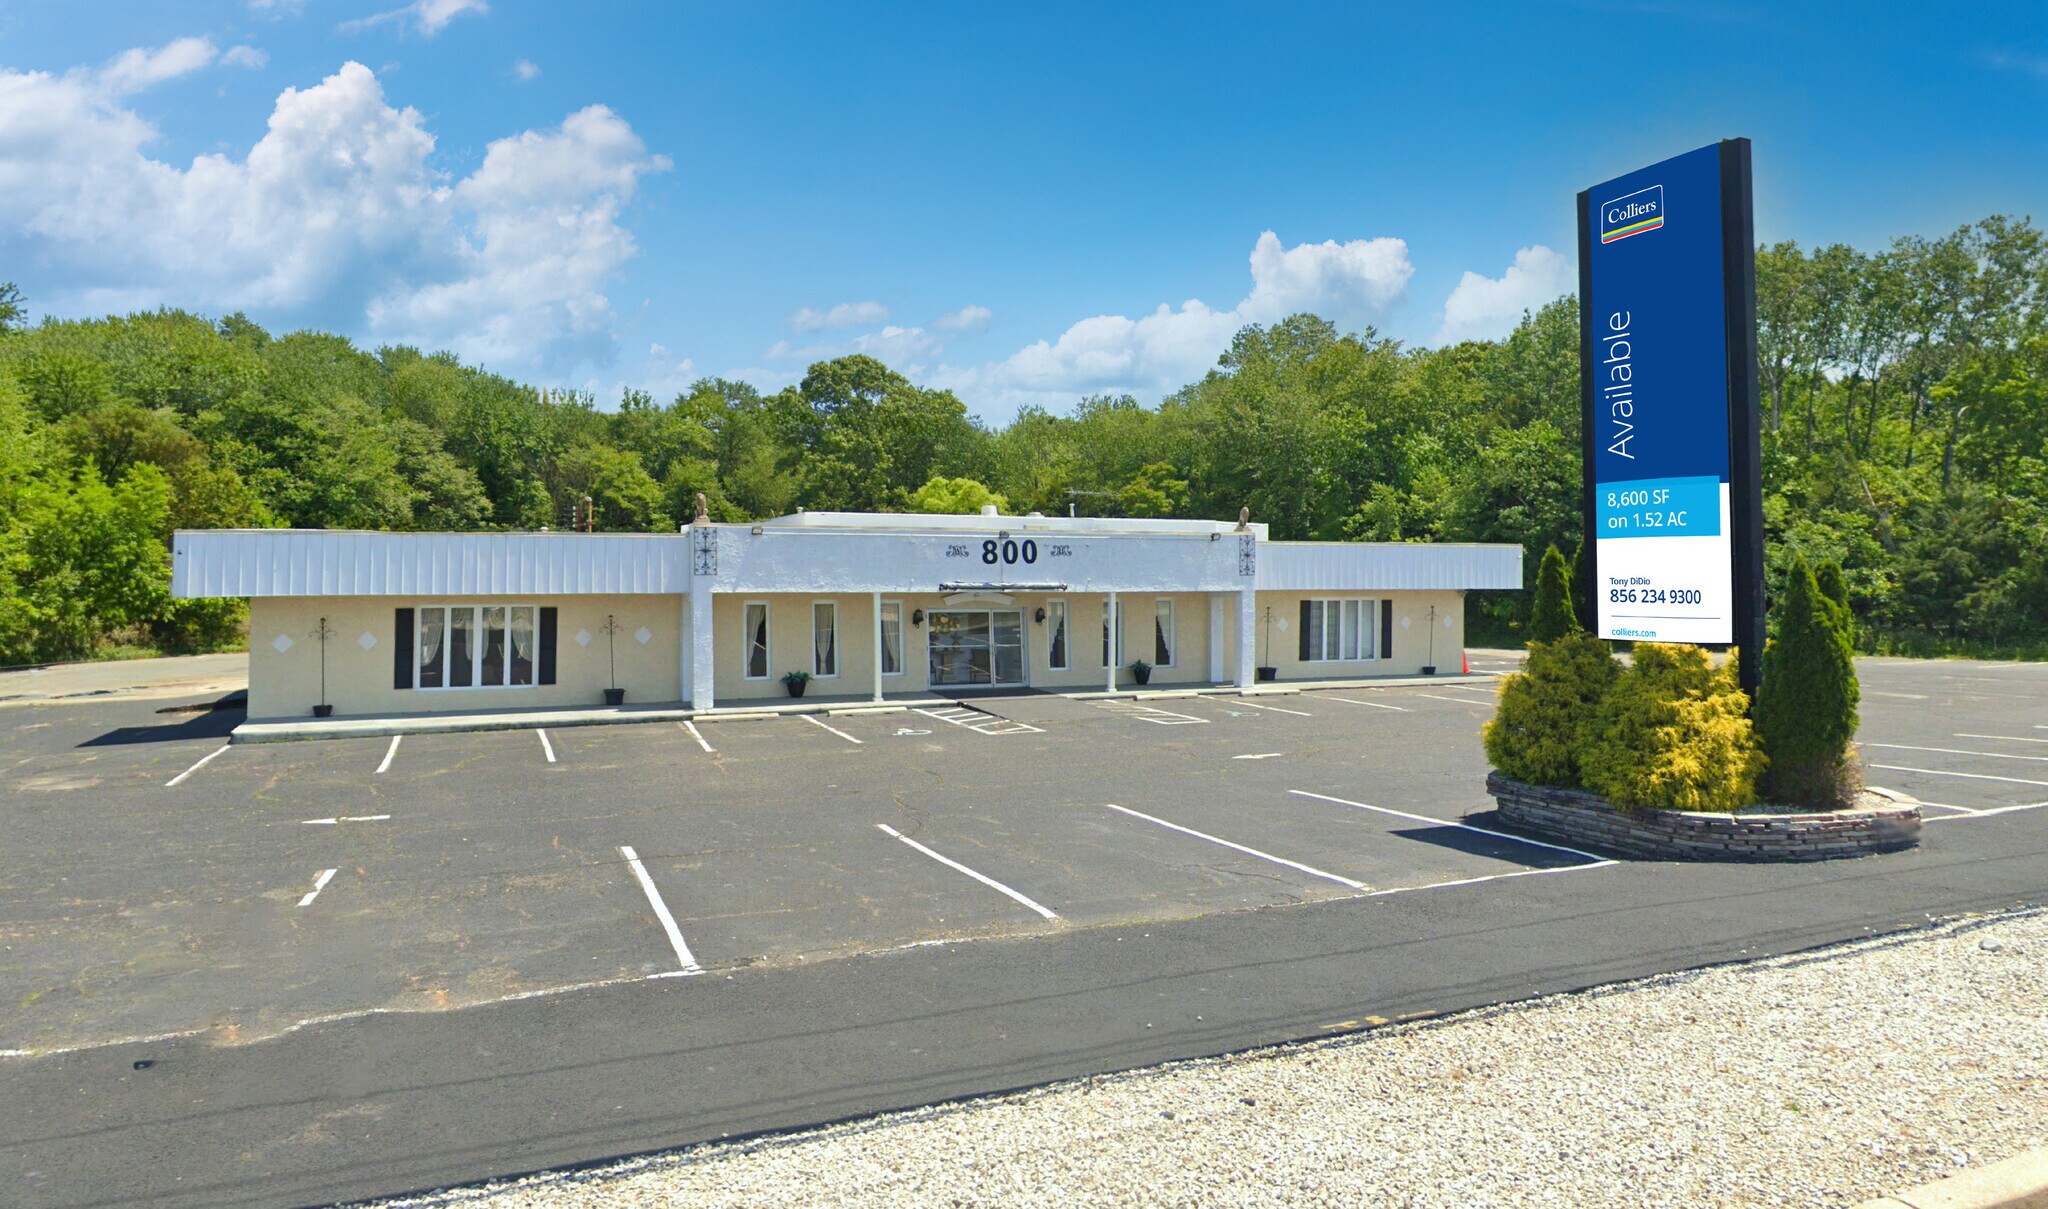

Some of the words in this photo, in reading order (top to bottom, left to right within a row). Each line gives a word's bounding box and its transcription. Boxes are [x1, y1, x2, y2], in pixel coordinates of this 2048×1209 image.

[1608, 199, 1657, 224] Colliers
[1603, 310, 1635, 460] Available
[1607, 490, 1649, 509] 8,600
[1653, 488, 1670, 505] SF
[1608, 515, 1628, 529] on
[1633, 511, 1663, 528] 1.52
[1667, 511, 1687, 527] AC
[981, 539, 1038, 565] 800
[1609, 577, 1628, 587] Tony
[1630, 577, 1651, 586] DiDio
[1610, 589, 1637, 603] 856
[1641, 589, 1667, 604] 234
[1669, 590, 1702, 604] 9300
[1611, 627, 1657, 638] colliers.com
